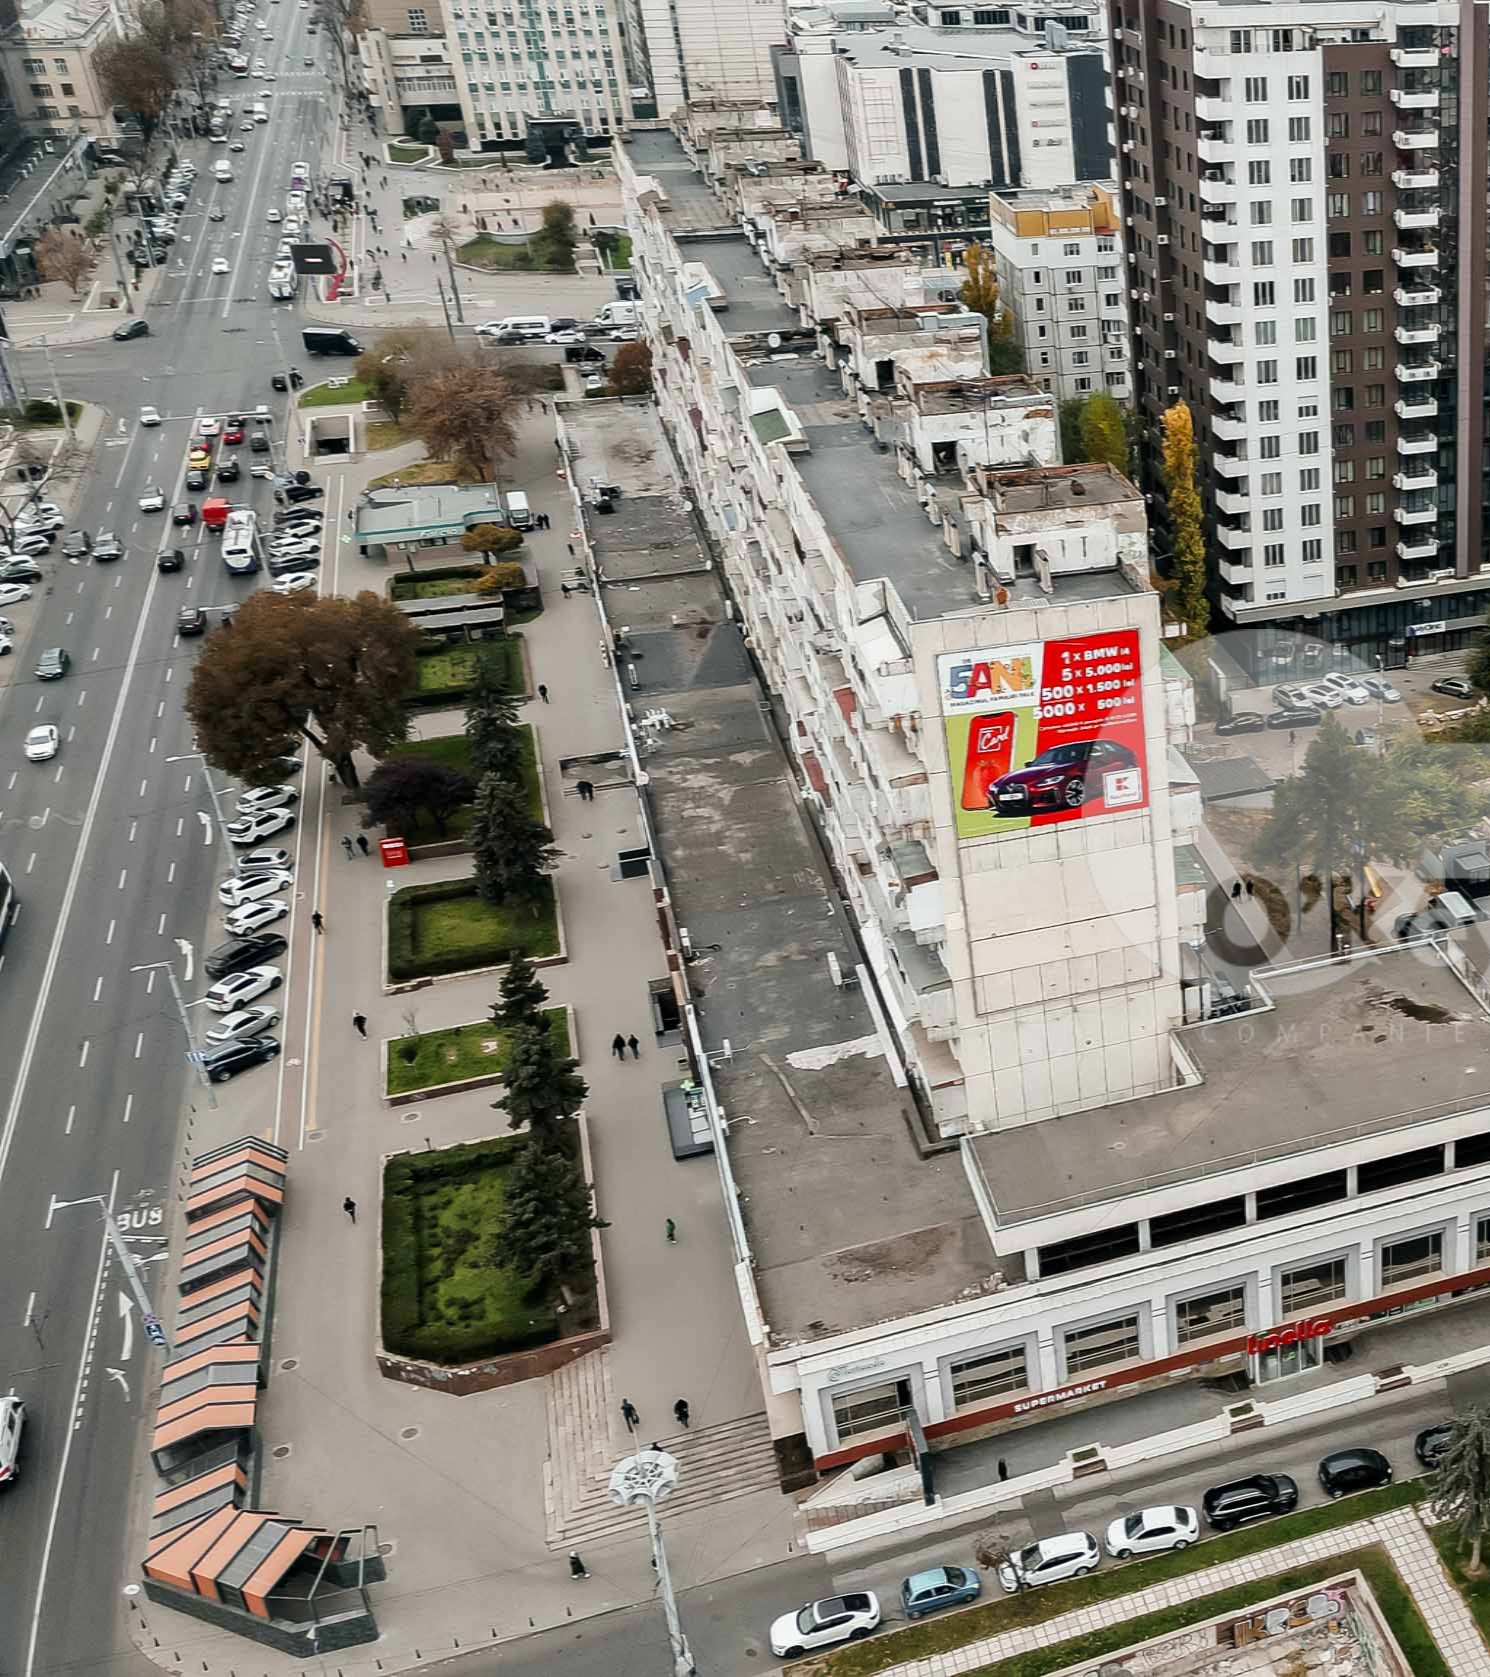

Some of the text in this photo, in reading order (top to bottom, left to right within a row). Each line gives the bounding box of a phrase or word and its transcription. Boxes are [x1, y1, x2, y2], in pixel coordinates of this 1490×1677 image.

[1060, 650, 1071, 665] 1
[1083, 646, 1119, 661] BMW
[1061, 668, 1073, 681] 5
[1085, 663, 1122, 677] 5.000
[1041, 684, 1074, 701] 500
[1086, 679, 1121, 694] 1.500
[1033, 702, 1076, 719] 5000
[1096, 696, 1122, 710] 500
[114, 1206, 163, 1232] BUS
[1013, 1380, 1108, 1413] SUPERMARKET
